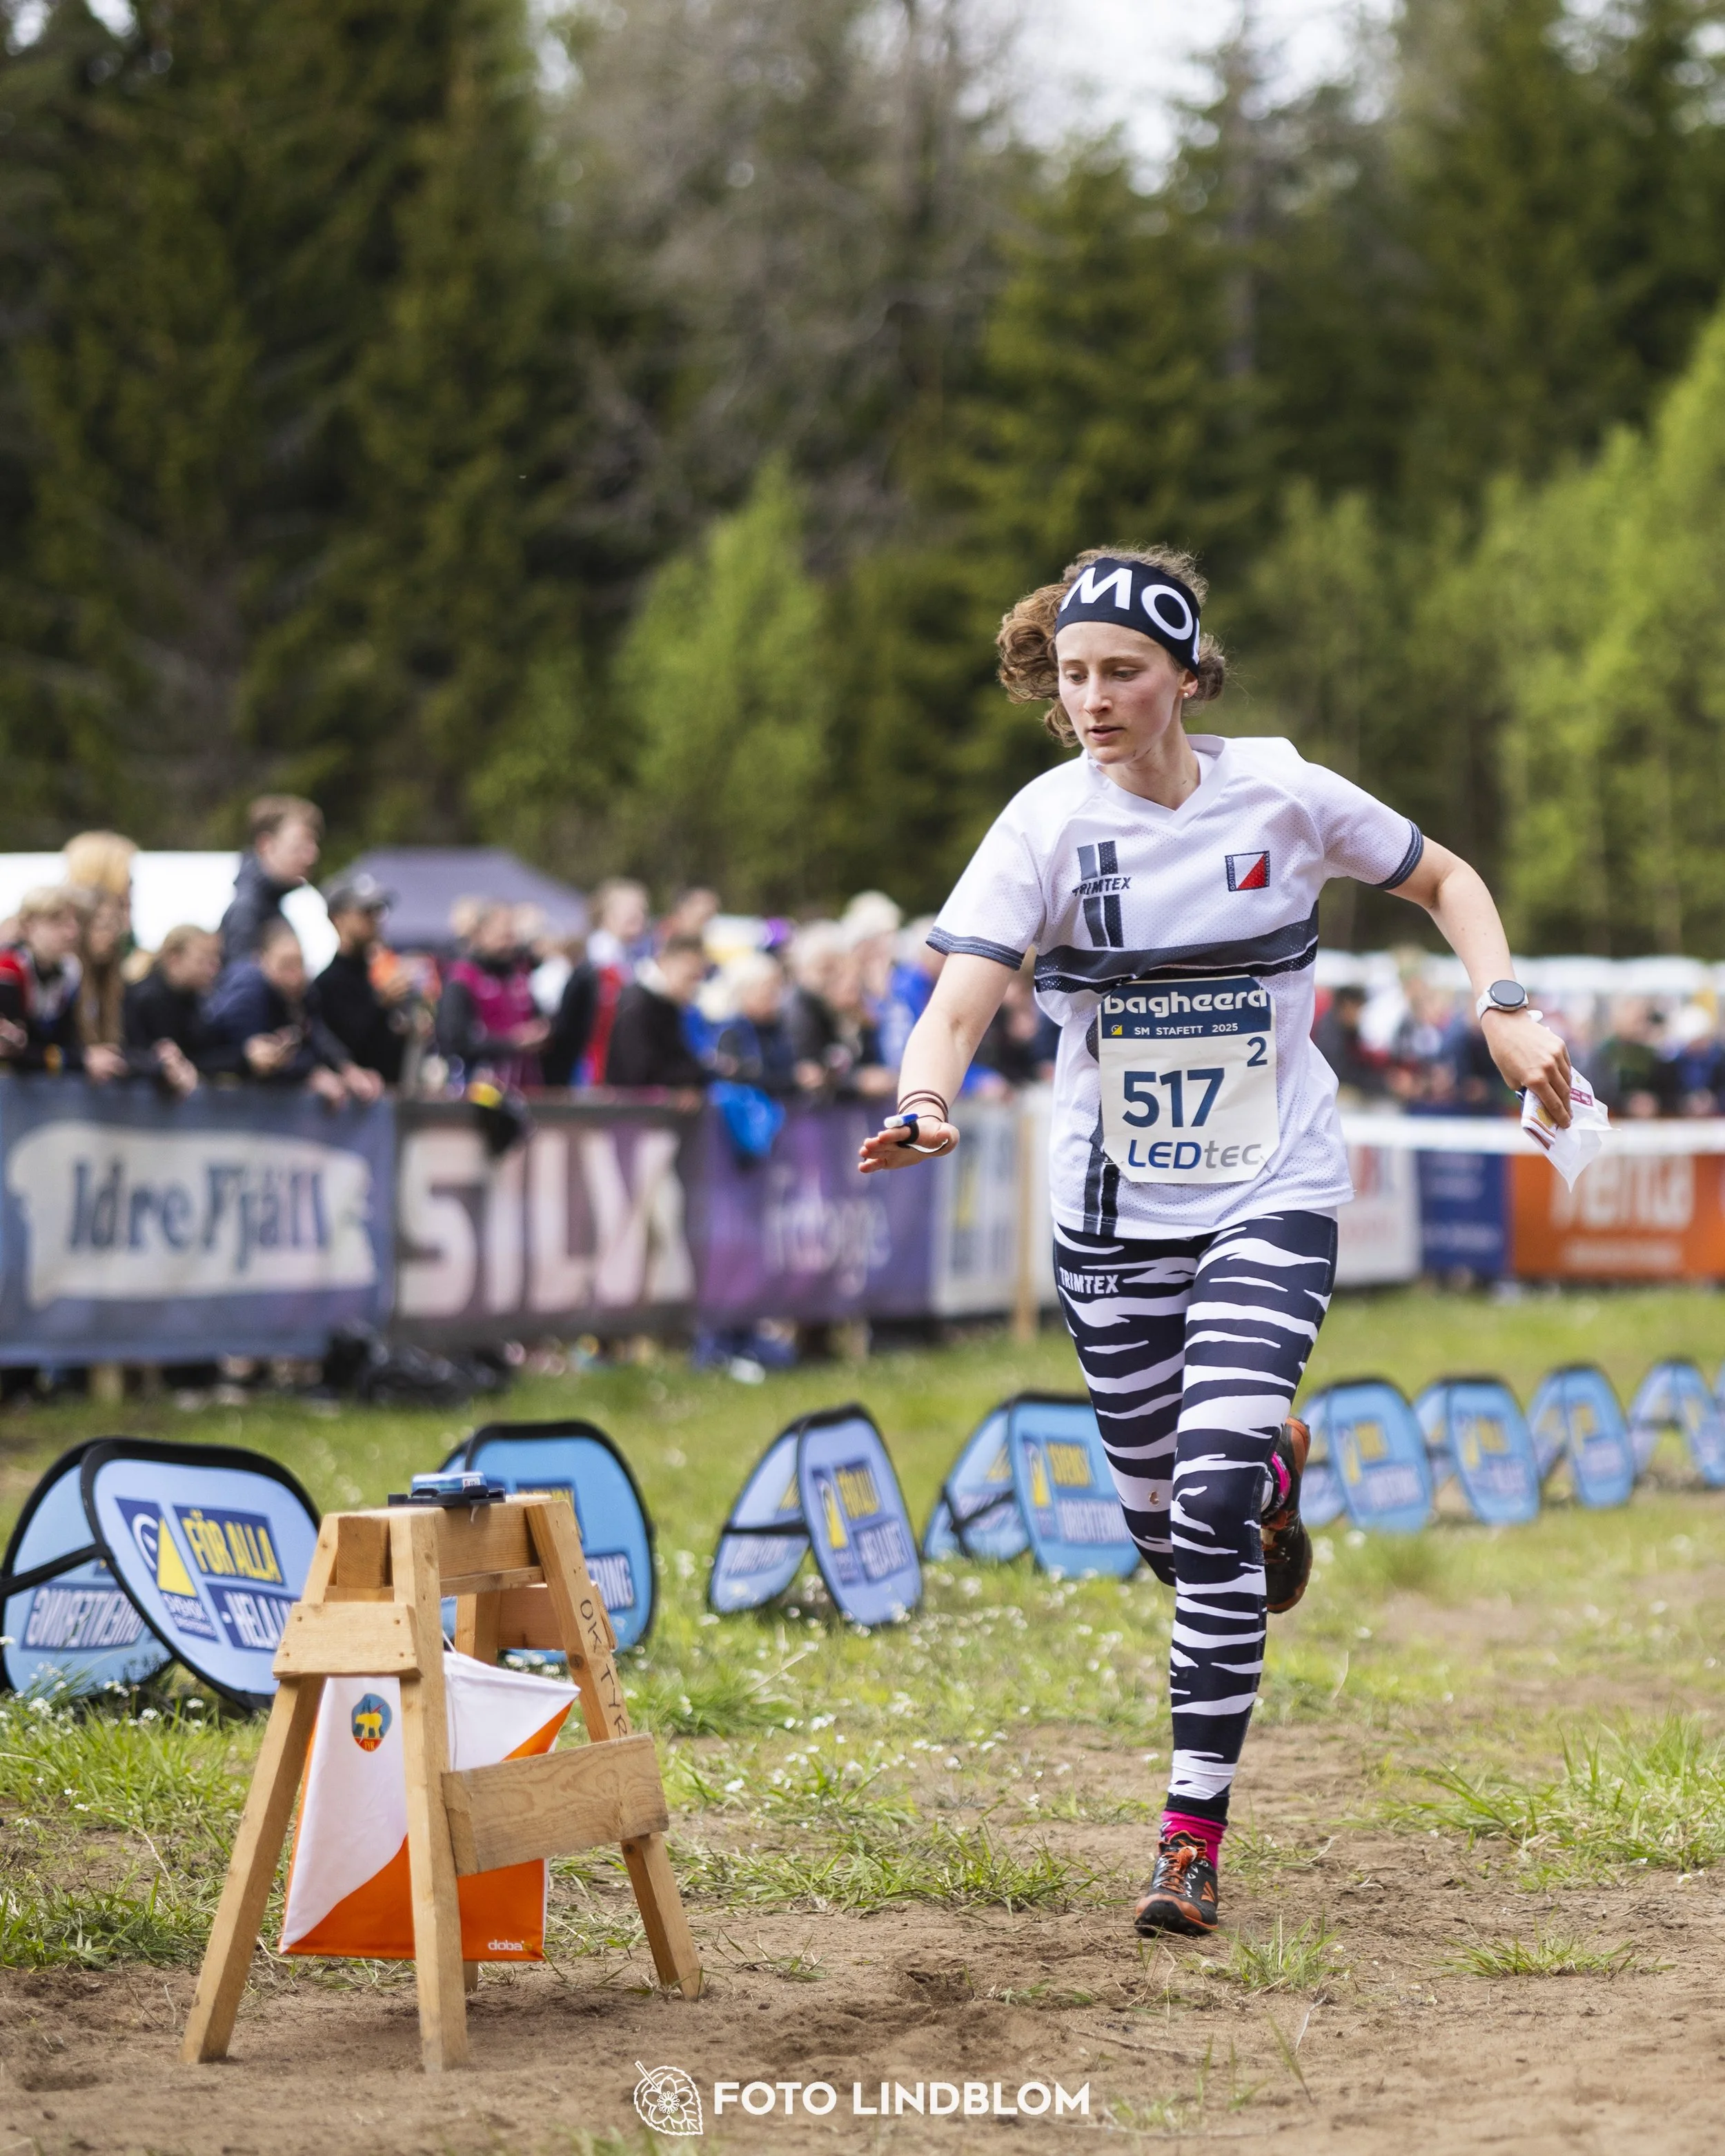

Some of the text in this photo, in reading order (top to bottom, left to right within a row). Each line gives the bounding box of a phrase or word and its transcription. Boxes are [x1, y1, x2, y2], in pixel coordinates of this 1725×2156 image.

[1061, 567, 1199, 664] MO
[1072, 877, 1132, 897] TRIMTEX
[1104, 989, 1267, 1018] bagheera
[1134, 1023, 1239, 1036] SM STAFETT 2025
[1247, 1036, 1268, 1067] 2
[1122, 1067, 1225, 1128] 517
[1127, 1139, 1262, 1169] LEDtec
[1059, 1267, 1119, 1294] TRIMTEX
[181, 1508, 283, 1584] FÖR ALLA
